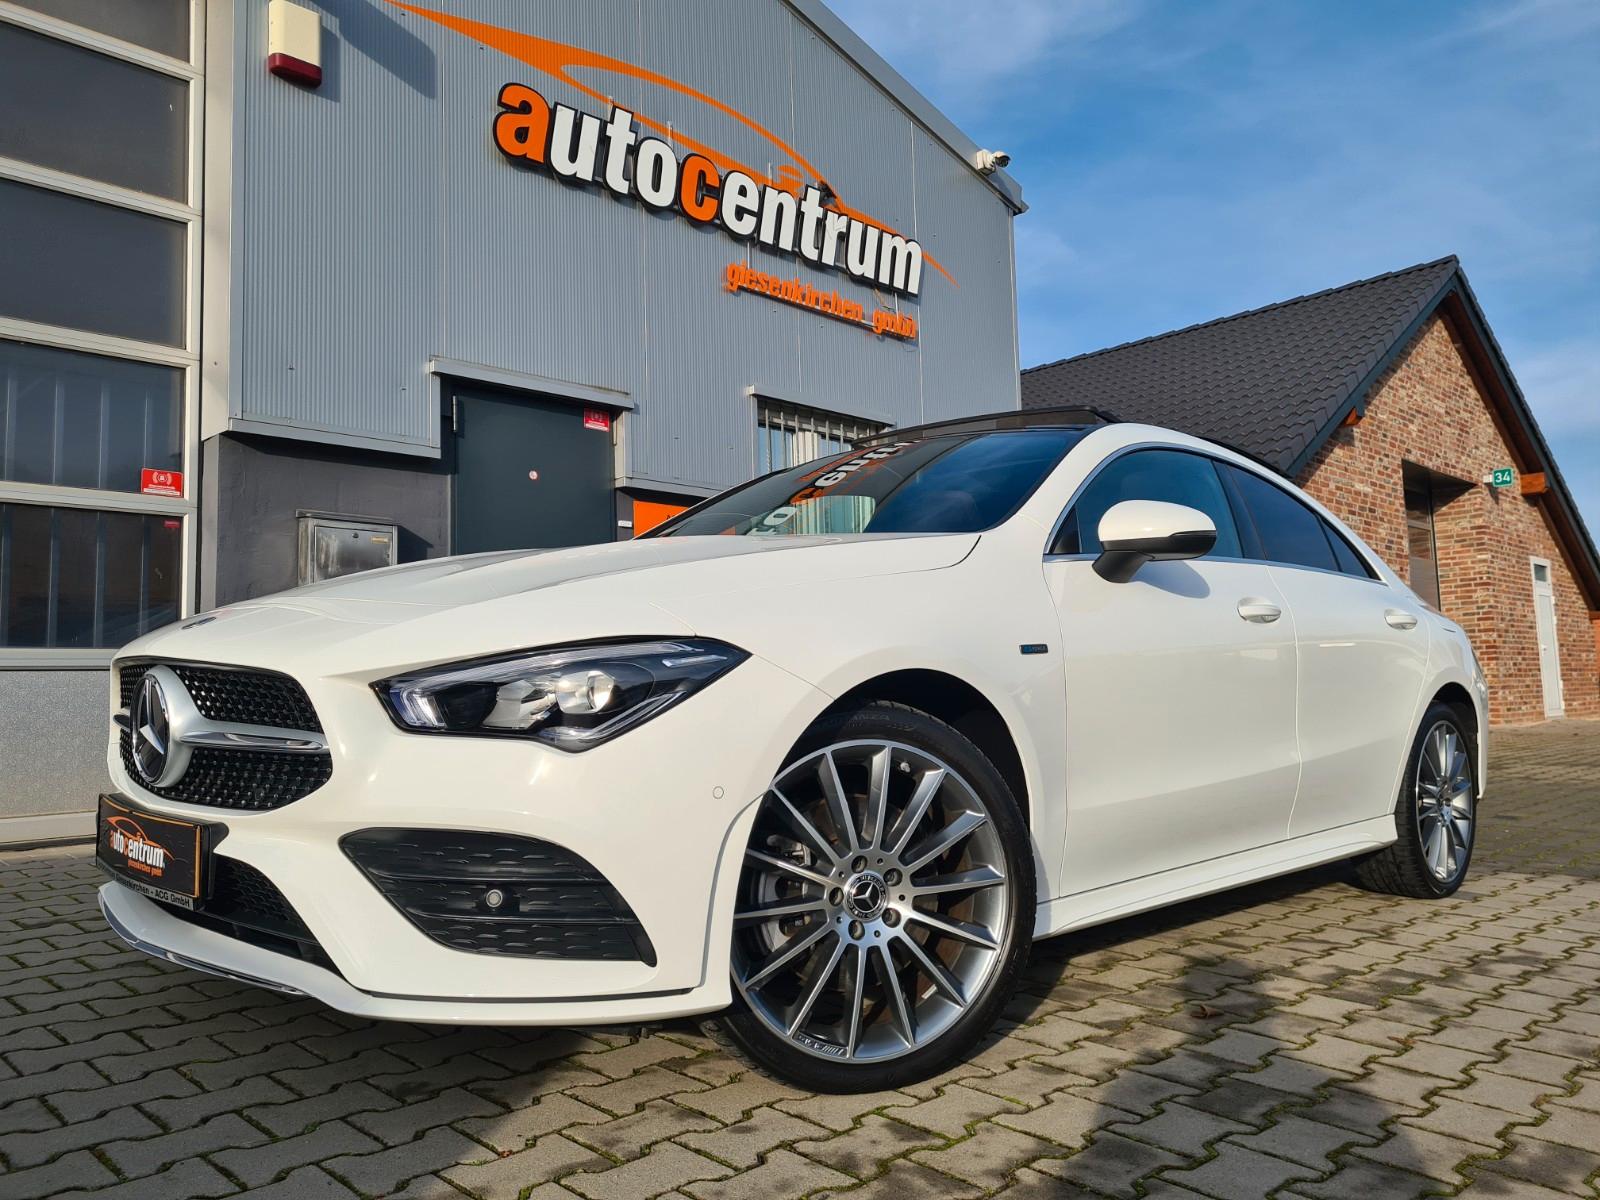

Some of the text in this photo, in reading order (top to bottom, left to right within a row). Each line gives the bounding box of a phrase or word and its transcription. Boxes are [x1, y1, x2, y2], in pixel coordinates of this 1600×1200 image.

[494, 83, 922, 297] autocentrum
[726, 259, 863, 321] giesenkirchen
[1495, 471, 1511, 483] 34
[110, 829, 164, 868] autocentrum
[155, 889, 169, 901] ACG
[170, 893, 190, 907] GmbH
